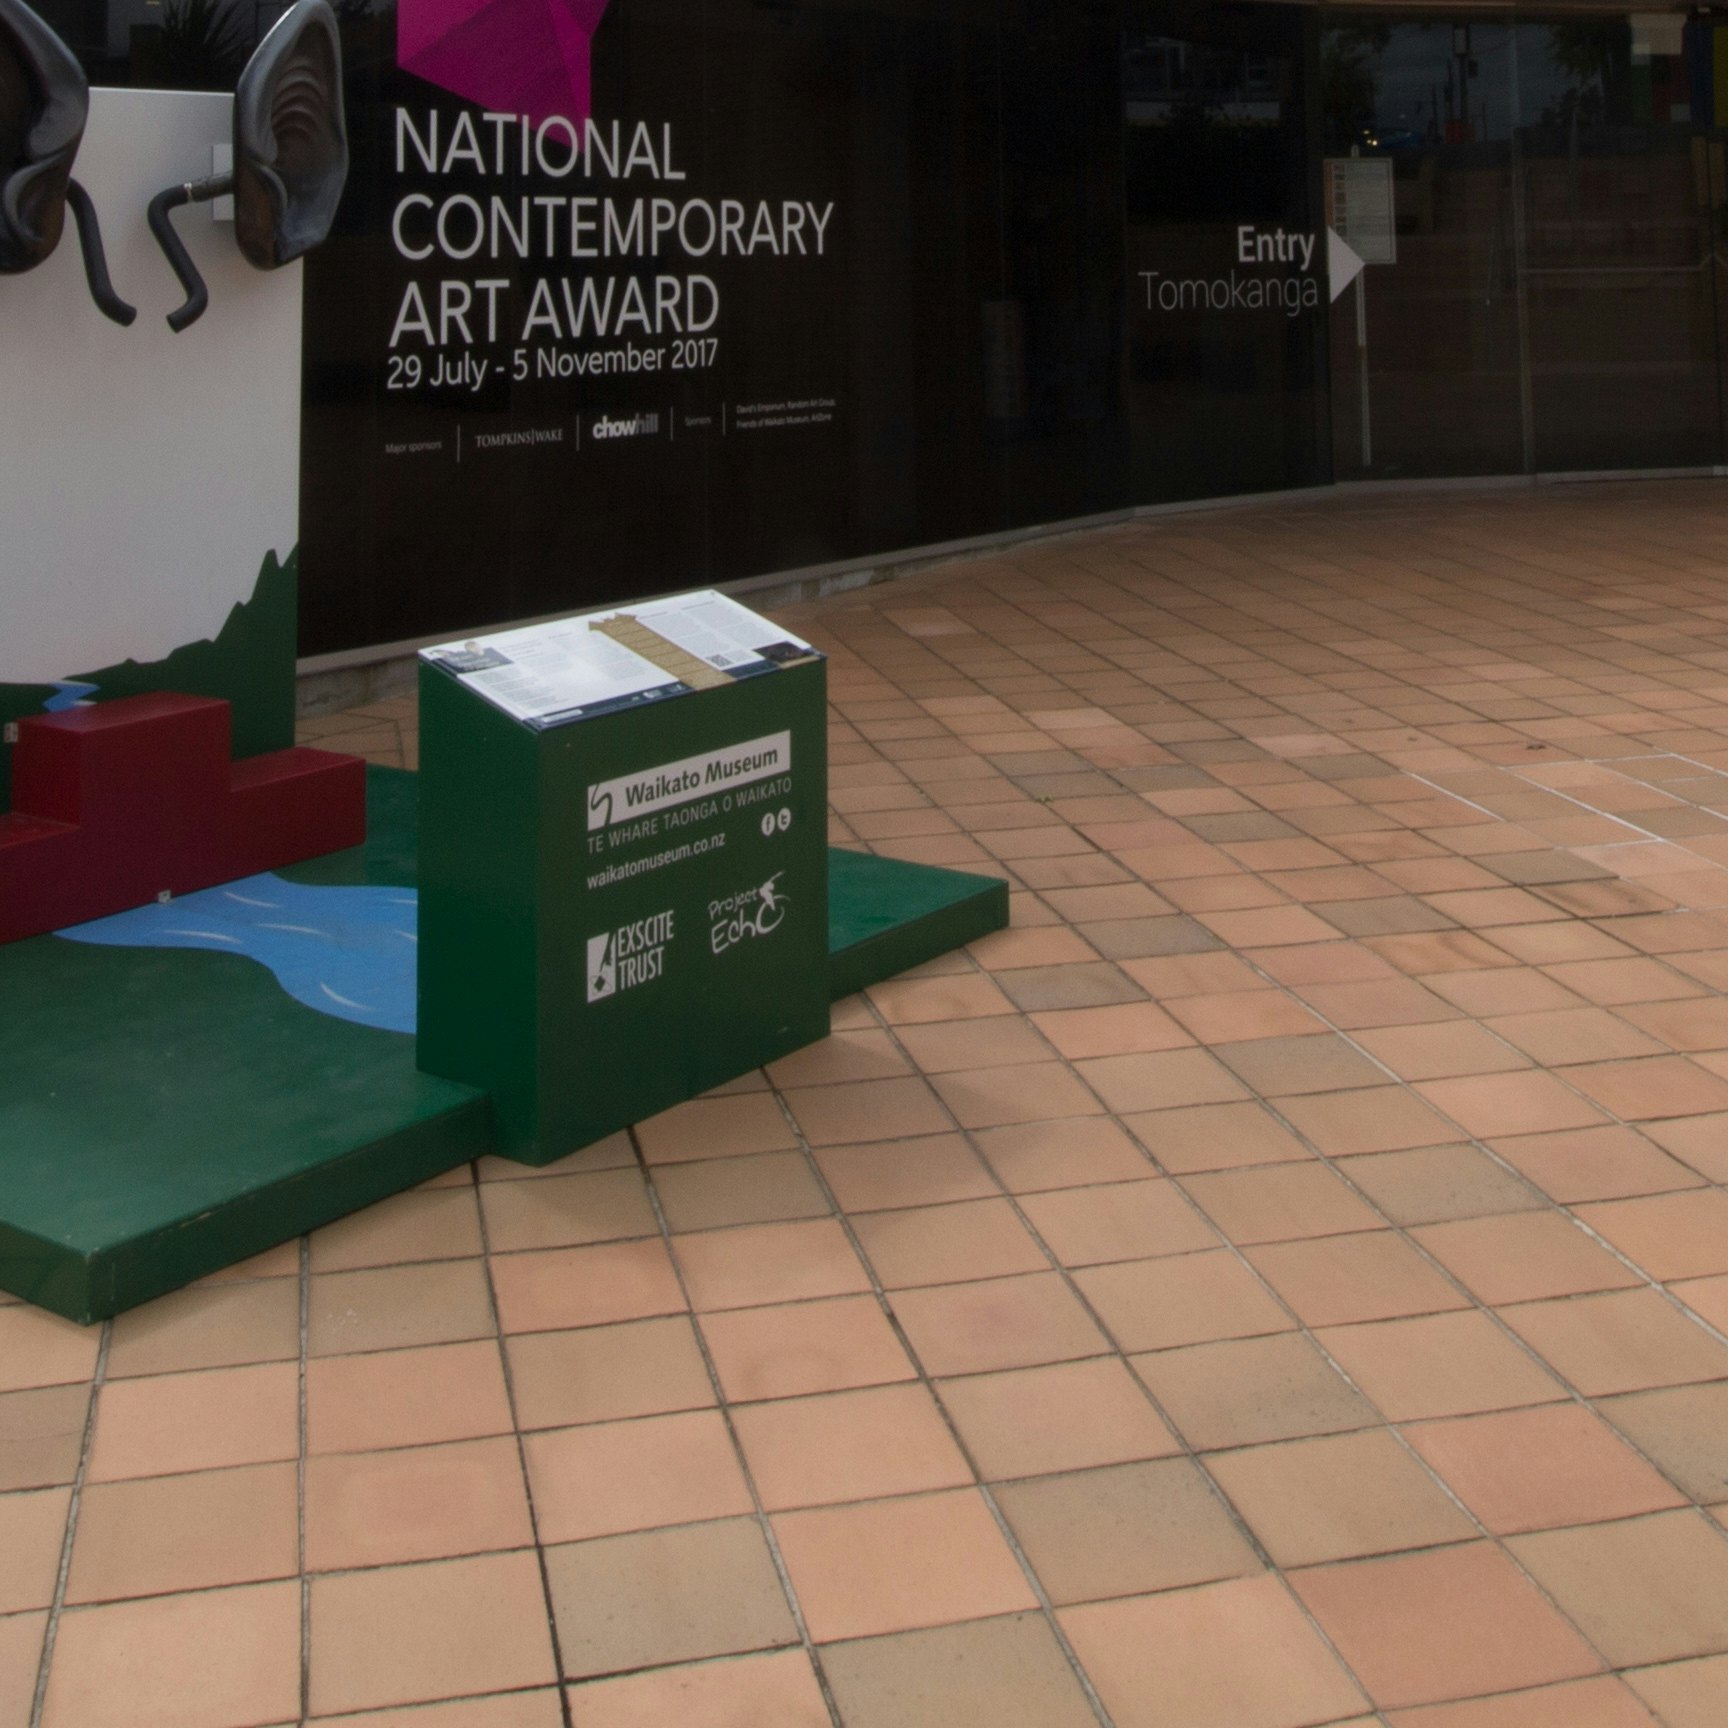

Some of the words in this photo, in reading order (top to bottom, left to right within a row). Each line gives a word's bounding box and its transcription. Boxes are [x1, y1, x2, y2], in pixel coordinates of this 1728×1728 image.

[395, 106, 686, 181] NATIONAL
[391, 193, 834, 260] CONTEMPORARY
[1237, 225, 1315, 271] Entry
[388, 279, 510, 349] ART
[522, 275, 719, 341] AWARD
[1138, 270, 1319, 317] Tomokanga
[387, 355, 421, 389] 29
[430, 351, 488, 391] July
[513, 349, 527, 381] 5
[537, 342, 665, 379] November
[671, 338, 718, 369] 2017
[385, 443, 407, 454] Major
[408, 441, 442, 453] sponsors
[593, 414, 658, 440] chowhill
[625, 770, 700, 807] Waikato
[704, 749, 778, 784] Museum
[587, 834, 604, 855] TE
[608, 818, 658, 848] WHARE
[663, 800, 719, 831] TAONGA
[723, 795, 732, 812] O
[736, 777, 792, 808] WAIKATO
[587, 832, 726, 891] waikatomuseum.co.nz
[707, 886, 758, 921] Project
[617, 909, 674, 958] EXSCITE
[618, 946, 665, 991] TRUST
